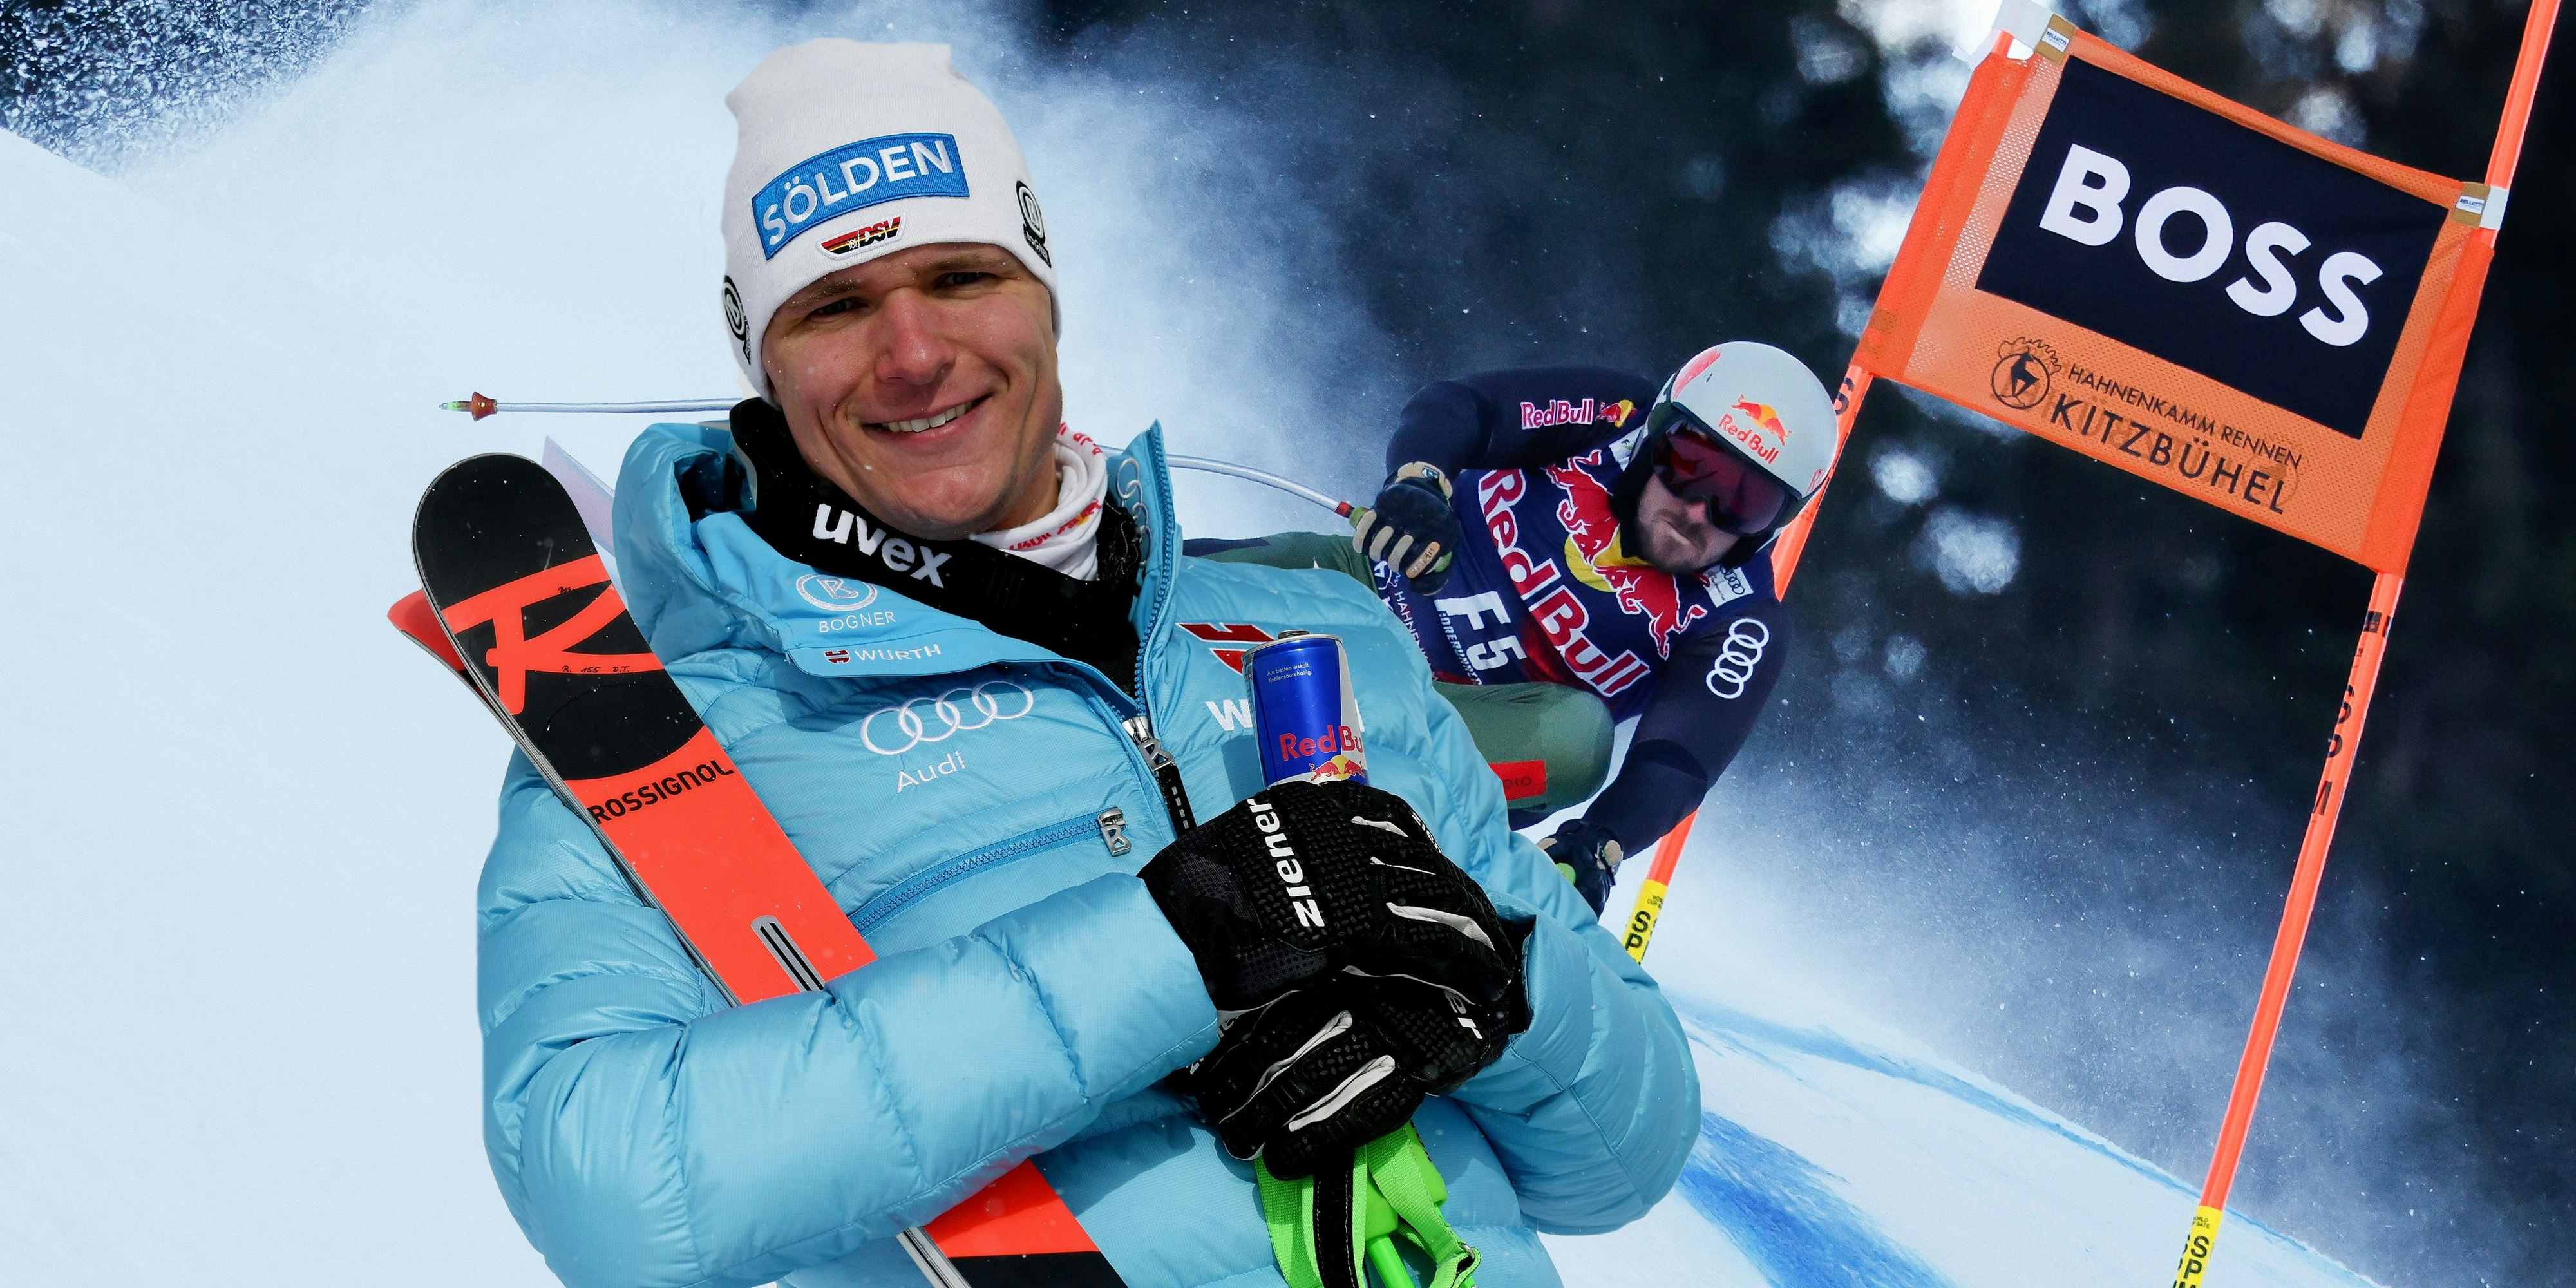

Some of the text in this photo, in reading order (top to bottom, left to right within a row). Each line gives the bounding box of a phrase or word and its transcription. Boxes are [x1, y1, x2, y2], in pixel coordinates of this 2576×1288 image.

[763, 141, 952, 245] SÖLDEN
[858, 216, 901, 247] DSV
[2040, 144, 2383, 346] BOSS
[1520, 398, 1594, 430] Red Bull
[1718, 414, 1779, 464] Red Bull
[2068, 364, 2302, 469] HAHNENKAMM RENNEN
[2050, 393, 2284, 515] KITZBÜHEL
[813, 503, 953, 588] uvex
[1478, 469, 1650, 697] Red Bull
[819, 611, 896, 633] BOGNER
[896, 751, 966, 793] Audi
[1279, 724, 1363, 762] Red Bu
[587, 759, 734, 825] ROSSIGNOL
[1246, 798, 1325, 927] ziener
